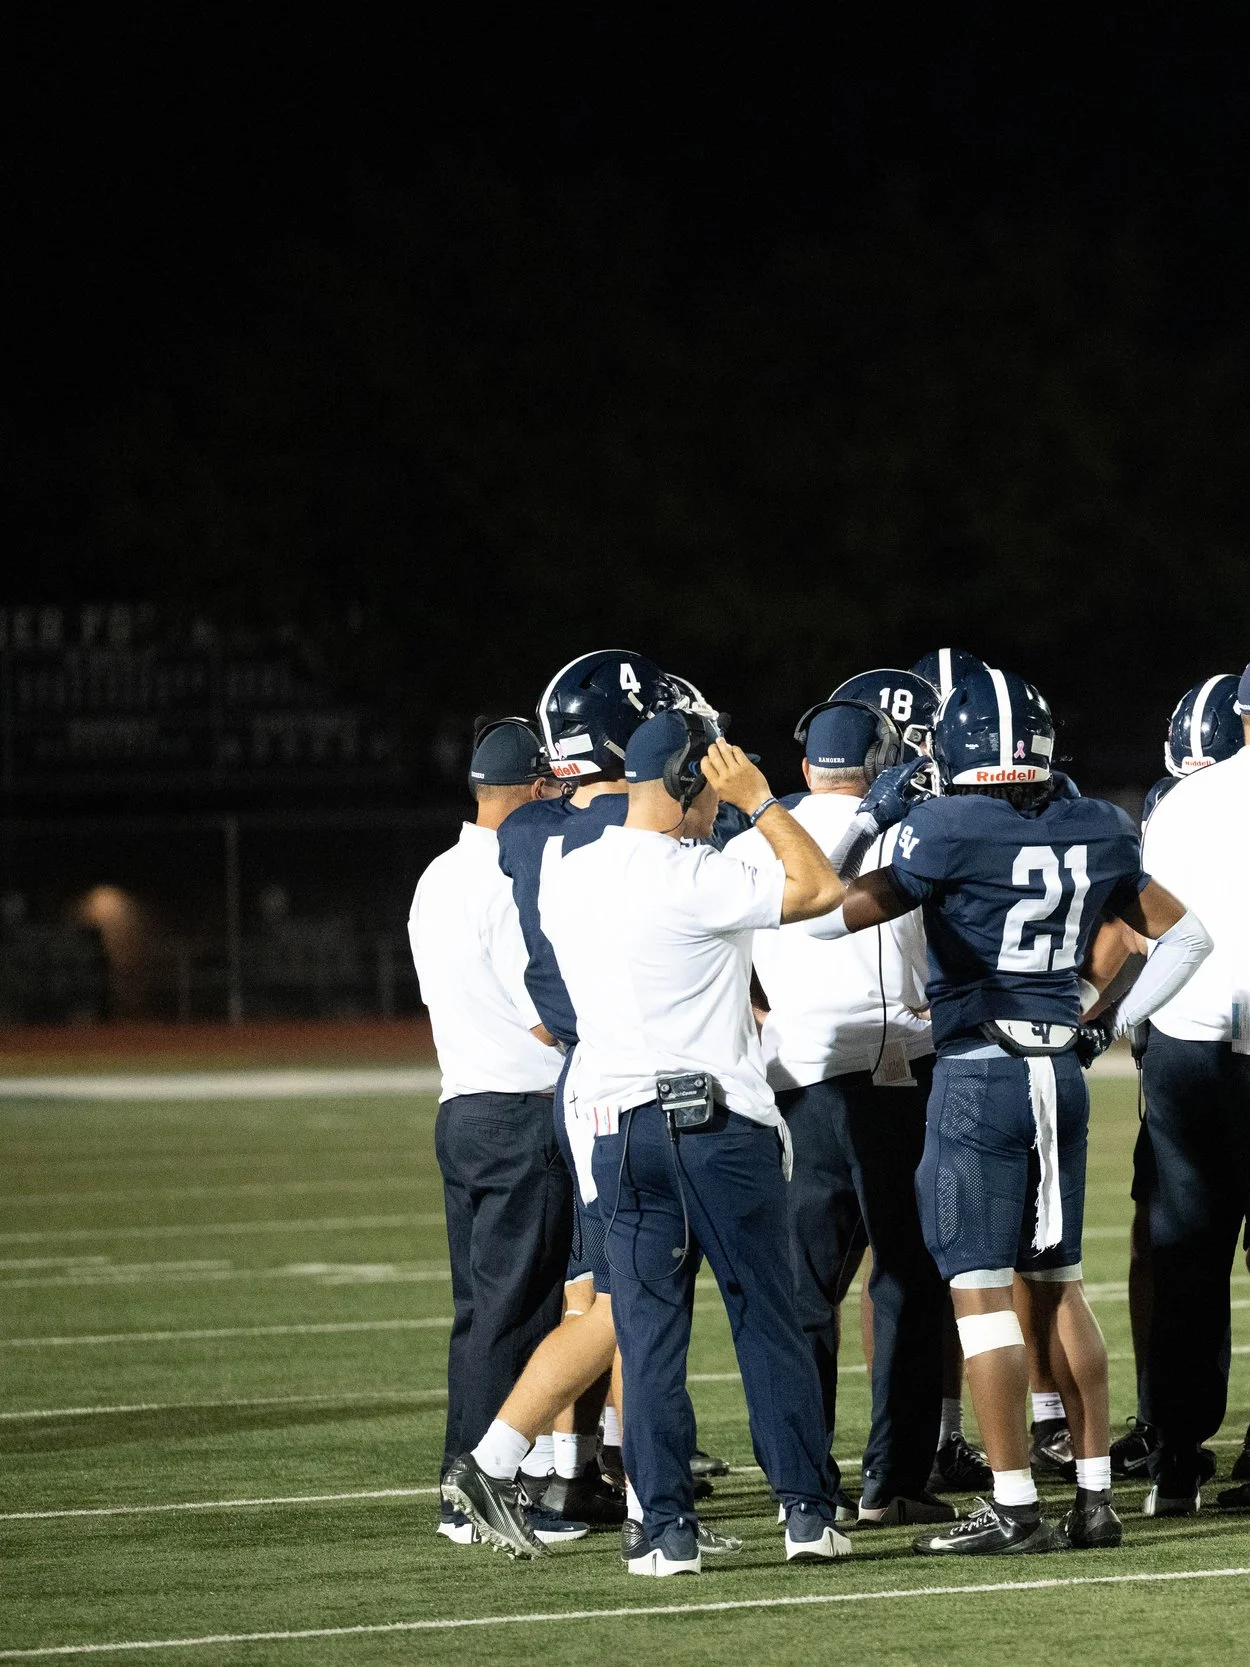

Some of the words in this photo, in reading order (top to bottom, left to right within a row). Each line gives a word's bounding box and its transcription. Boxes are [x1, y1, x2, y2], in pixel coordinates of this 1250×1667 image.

[619, 663, 641, 693] 4
[879, 688, 913, 722] 18
[976, 769, 1036, 782] Riddell
[899, 825, 920, 860] SV
[997, 845, 1091, 972] 21
